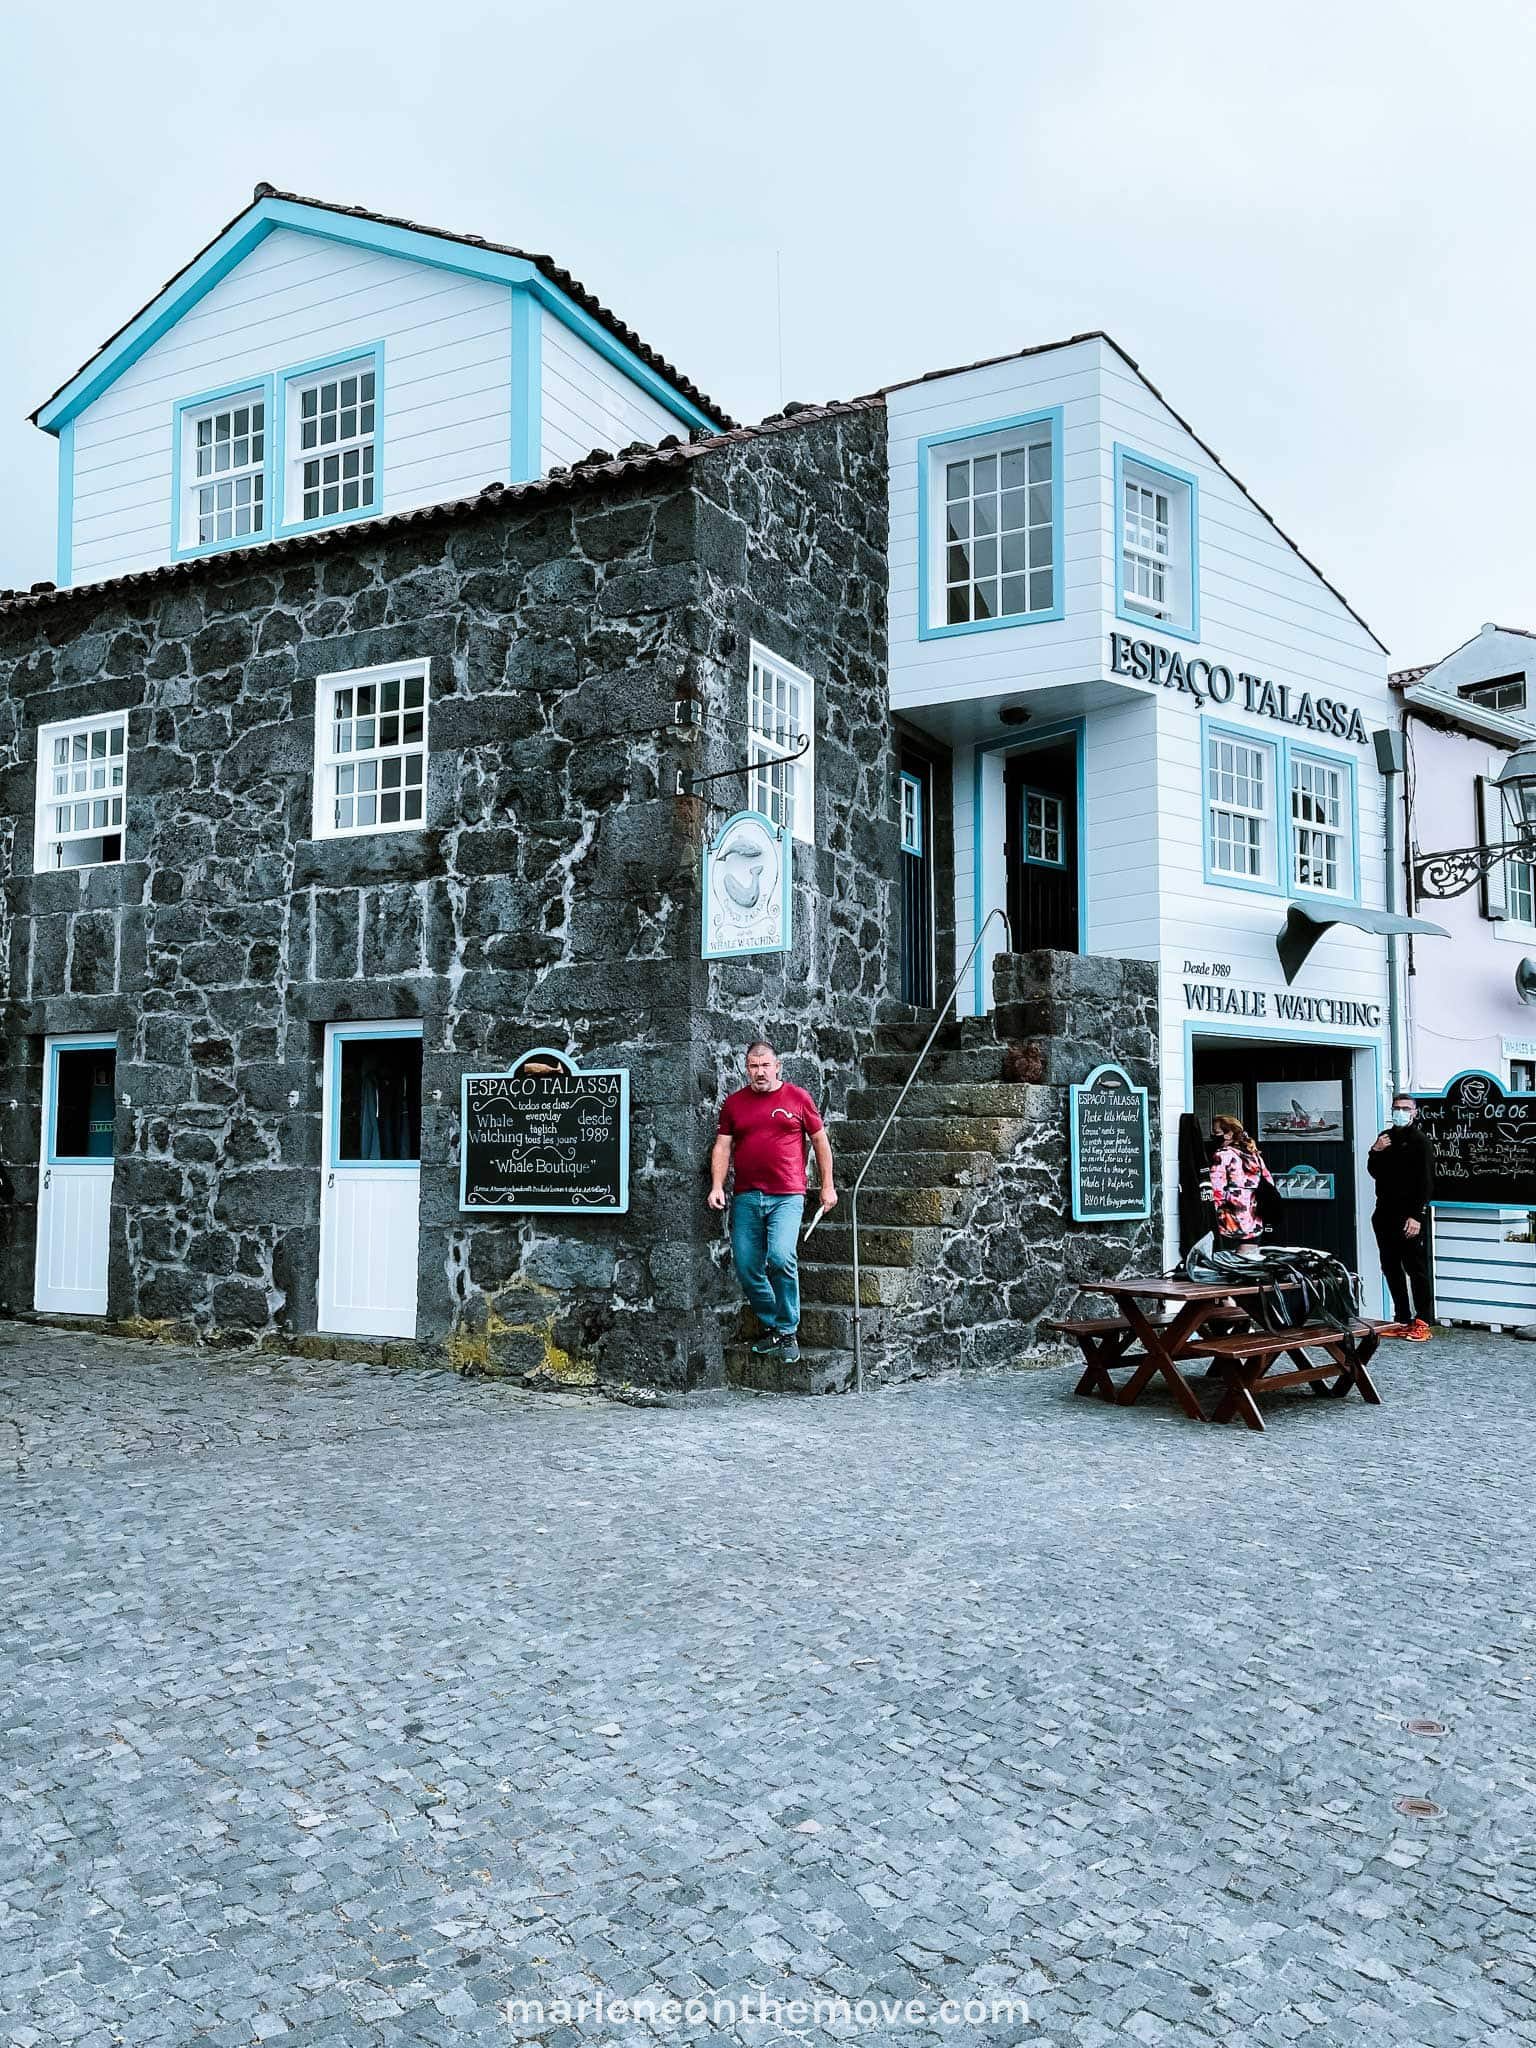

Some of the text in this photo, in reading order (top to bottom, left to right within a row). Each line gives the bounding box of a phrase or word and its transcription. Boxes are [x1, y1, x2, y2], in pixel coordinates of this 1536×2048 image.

[1110, 632, 1369, 744] ESPAÇO TALASSA
[1183, 960, 1231, 977] Desde 1989
[1183, 983, 1381, 1028] WHALE WATCHING
[469, 1077, 620, 1097] ESPAÇO TALASSA
[518, 1099, 540, 1110] todos
[541, 1101, 551, 1110] os
[1078, 1093, 1106, 1107] ESPAÇO
[1107, 1094, 1140, 1106] TALASSA
[475, 1113, 514, 1128] Whale
[525, 1110, 562, 1123] everyday
[577, 1106, 613, 1126] desde
[1416, 1105, 1446, 1120] Next
[469, 1130, 523, 1147] Watching
[525, 1134, 578, 1147] tous les jours
